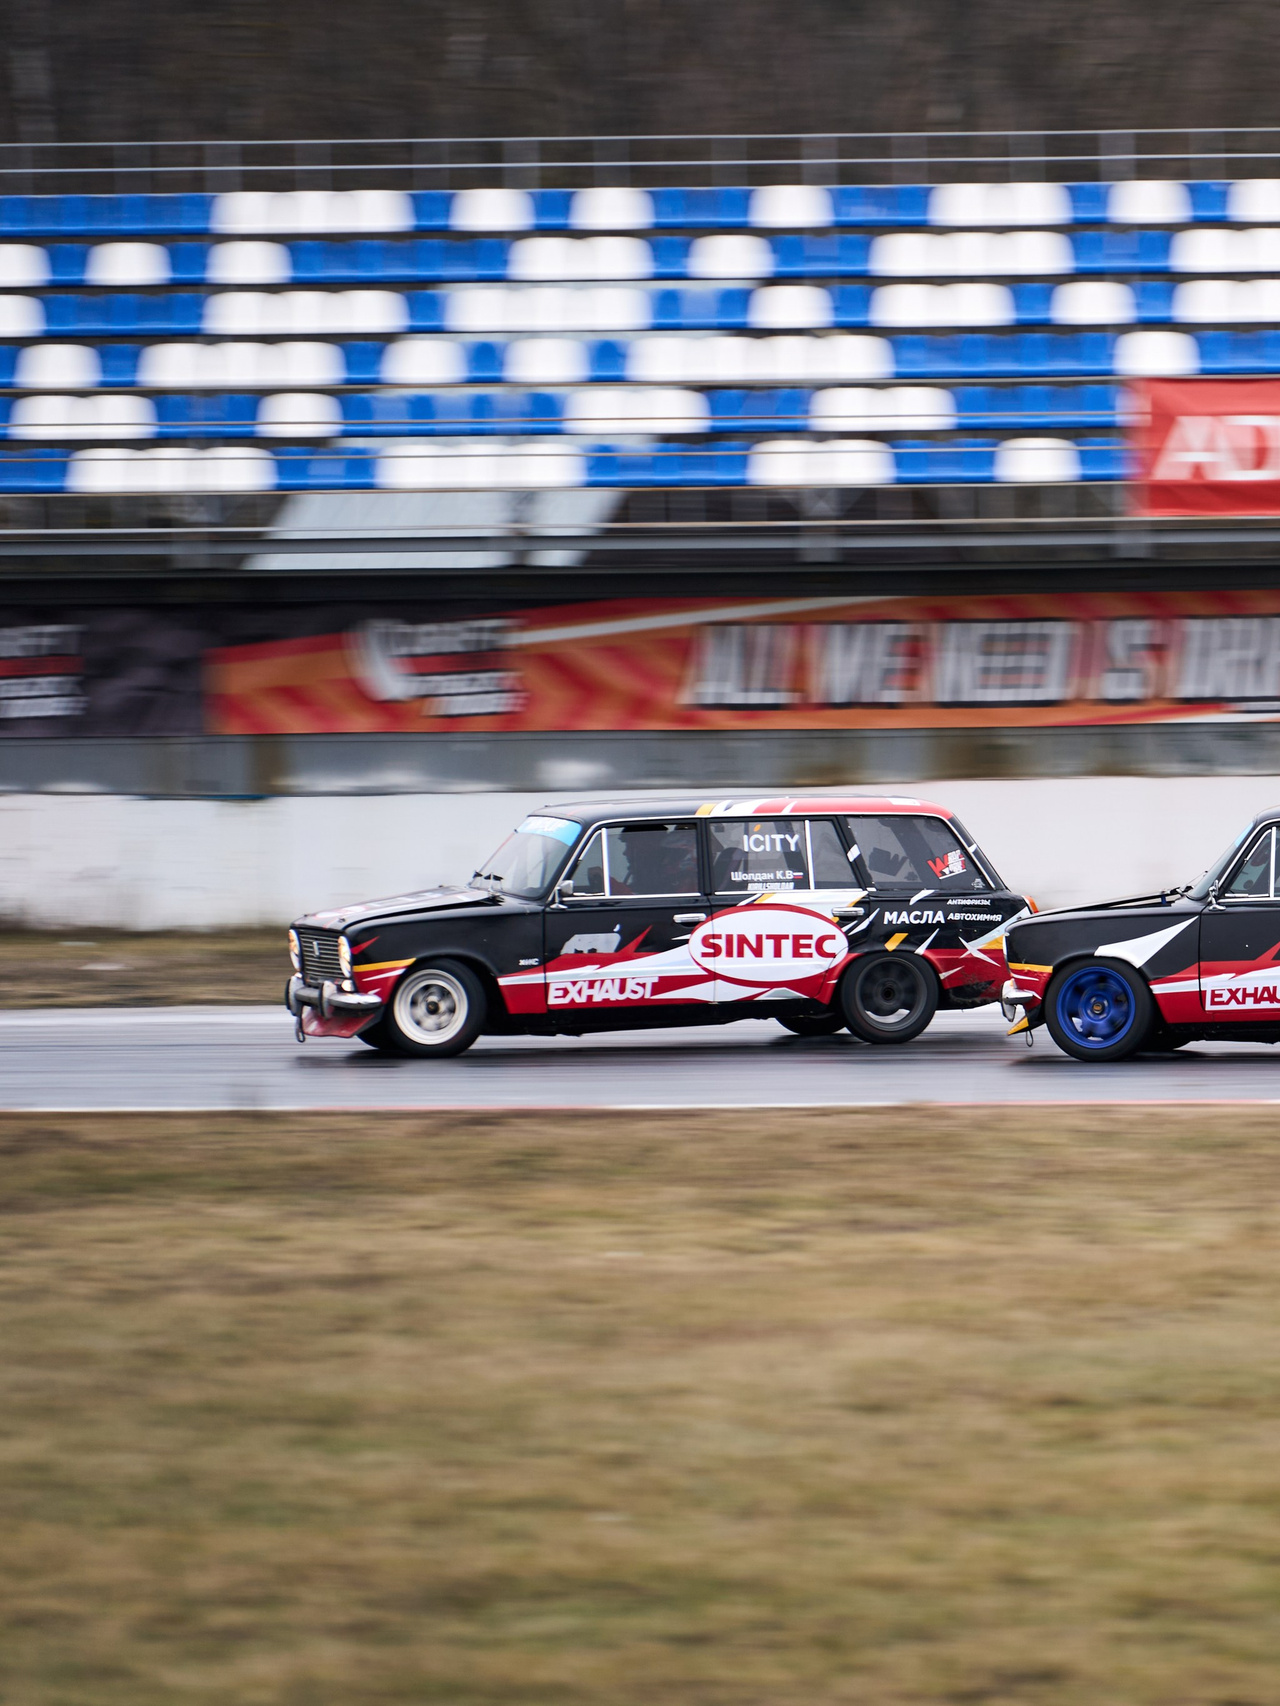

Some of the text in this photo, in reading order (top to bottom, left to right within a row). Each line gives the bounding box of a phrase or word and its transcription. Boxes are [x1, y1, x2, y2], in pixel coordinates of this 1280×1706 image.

[743, 834, 800, 852] ICITY
[731, 871, 775, 882] Шолдан
[883, 910, 945, 925] МАСЛА
[701, 933, 837, 959] SINTEC
[547, 975, 659, 1005] EXHAUST
